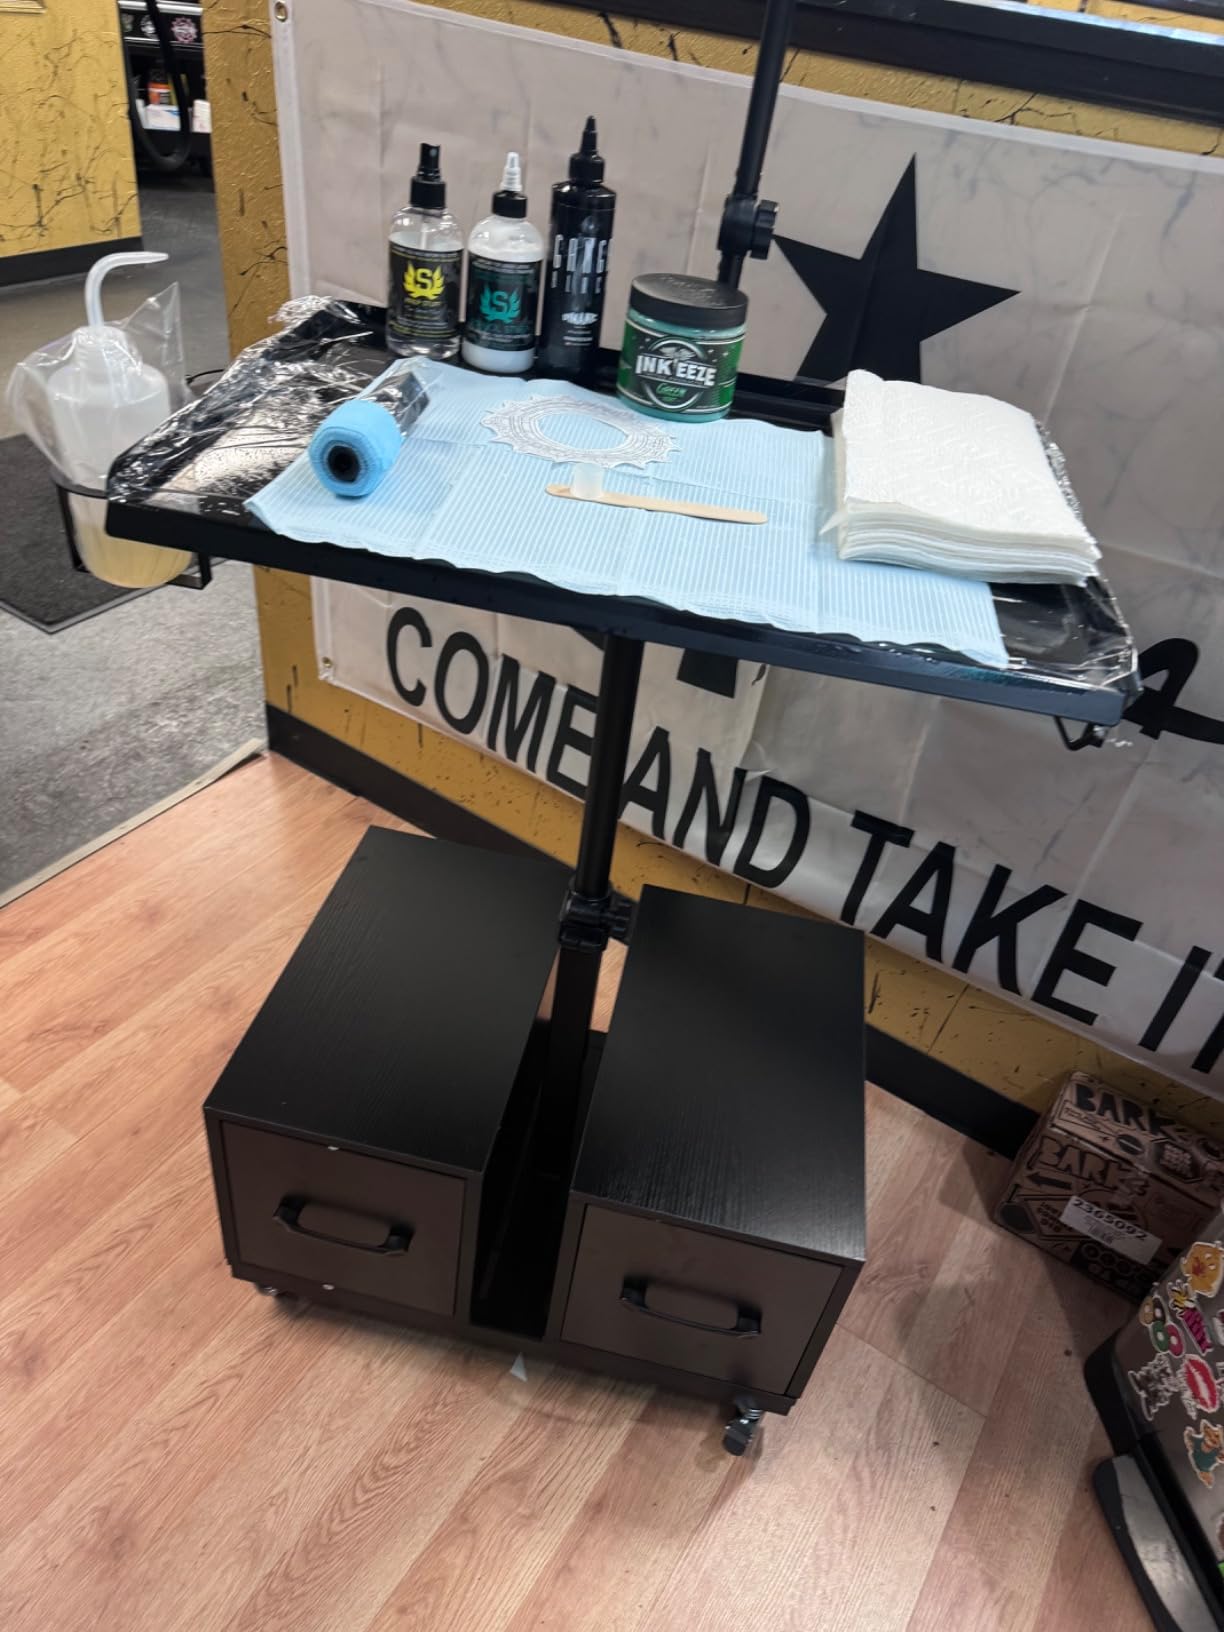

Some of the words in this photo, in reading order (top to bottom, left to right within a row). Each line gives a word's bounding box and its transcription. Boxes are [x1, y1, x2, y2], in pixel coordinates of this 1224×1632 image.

[635, 355, 673, 376] INK
[675, 363, 718, 387] EEZE
[386, 606, 600, 798] COME
[617, 725, 811, 889] AND
[840, 809, 1144, 1026] TAKE
